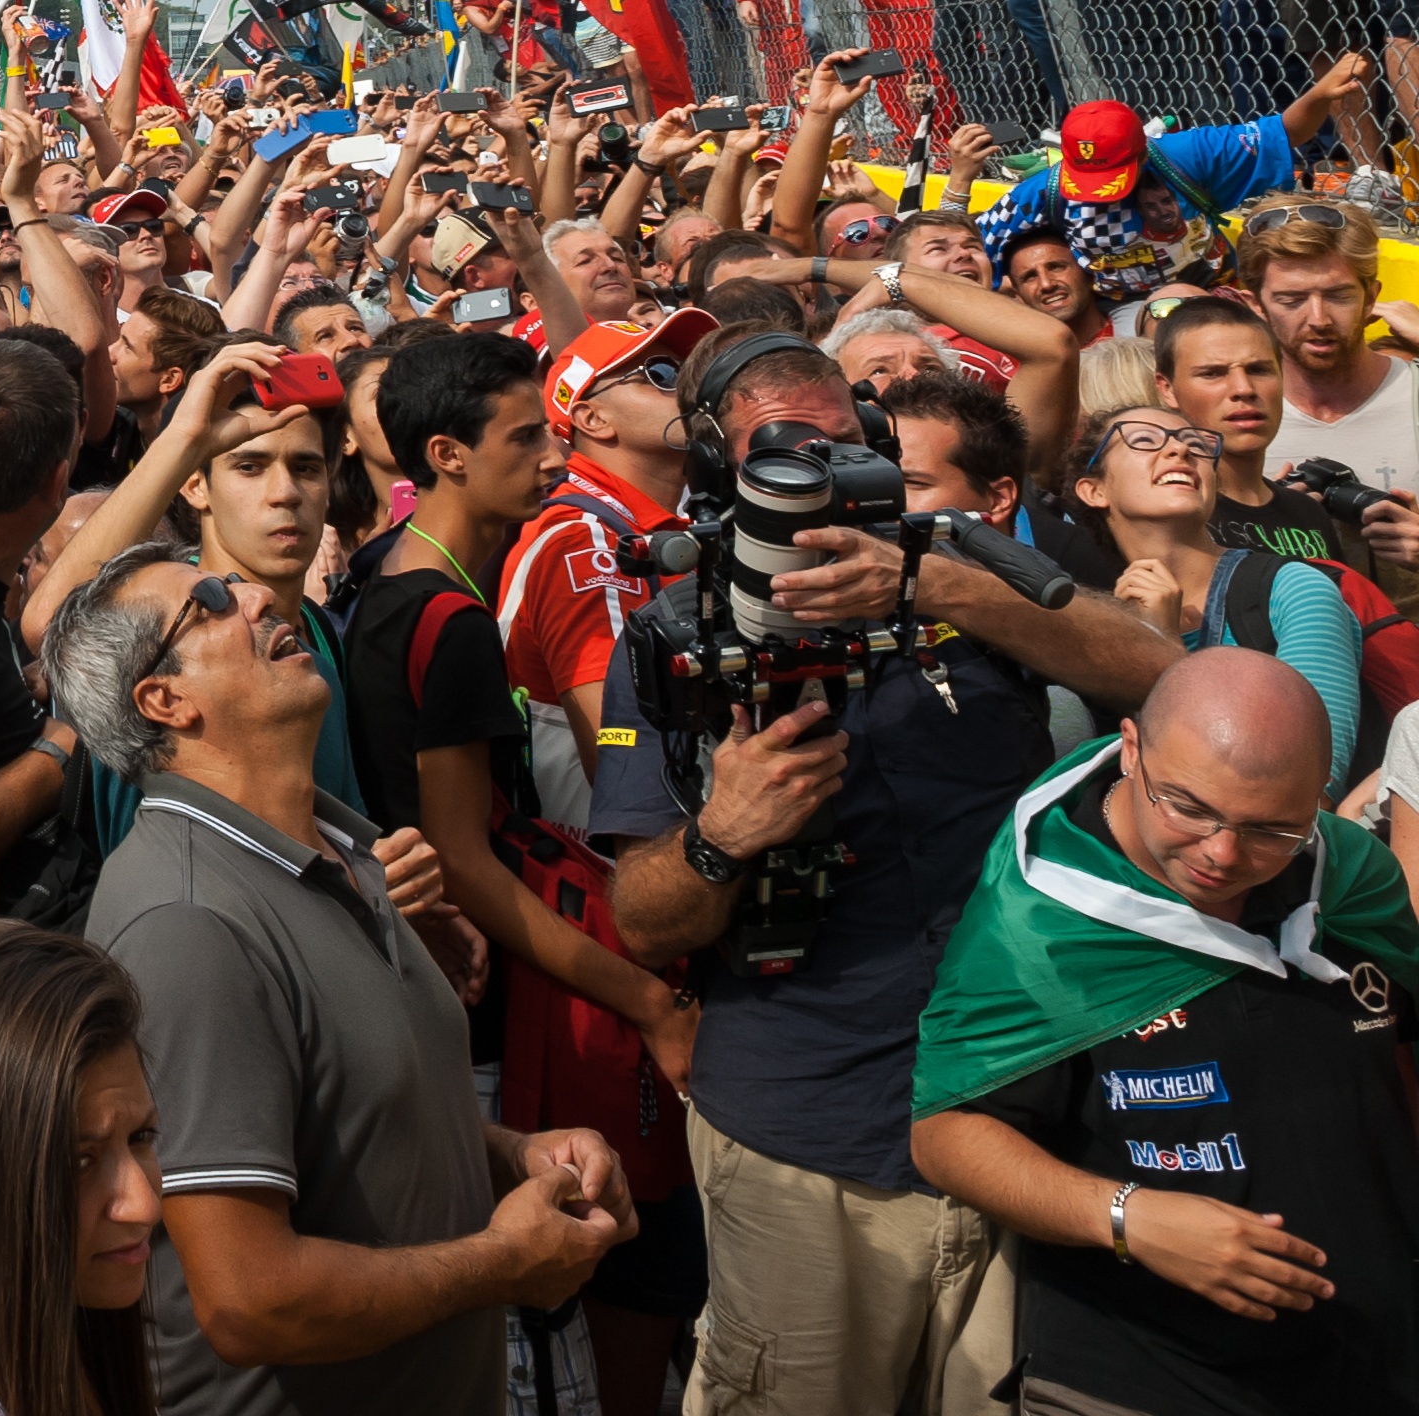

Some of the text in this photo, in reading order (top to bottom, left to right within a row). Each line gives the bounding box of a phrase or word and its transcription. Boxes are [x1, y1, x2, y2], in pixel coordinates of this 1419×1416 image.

[584, 574, 631, 589] vodafone
[1127, 1071, 1215, 1100] MICHELIN
[1126, 1133, 1246, 1171] Mobil 1
